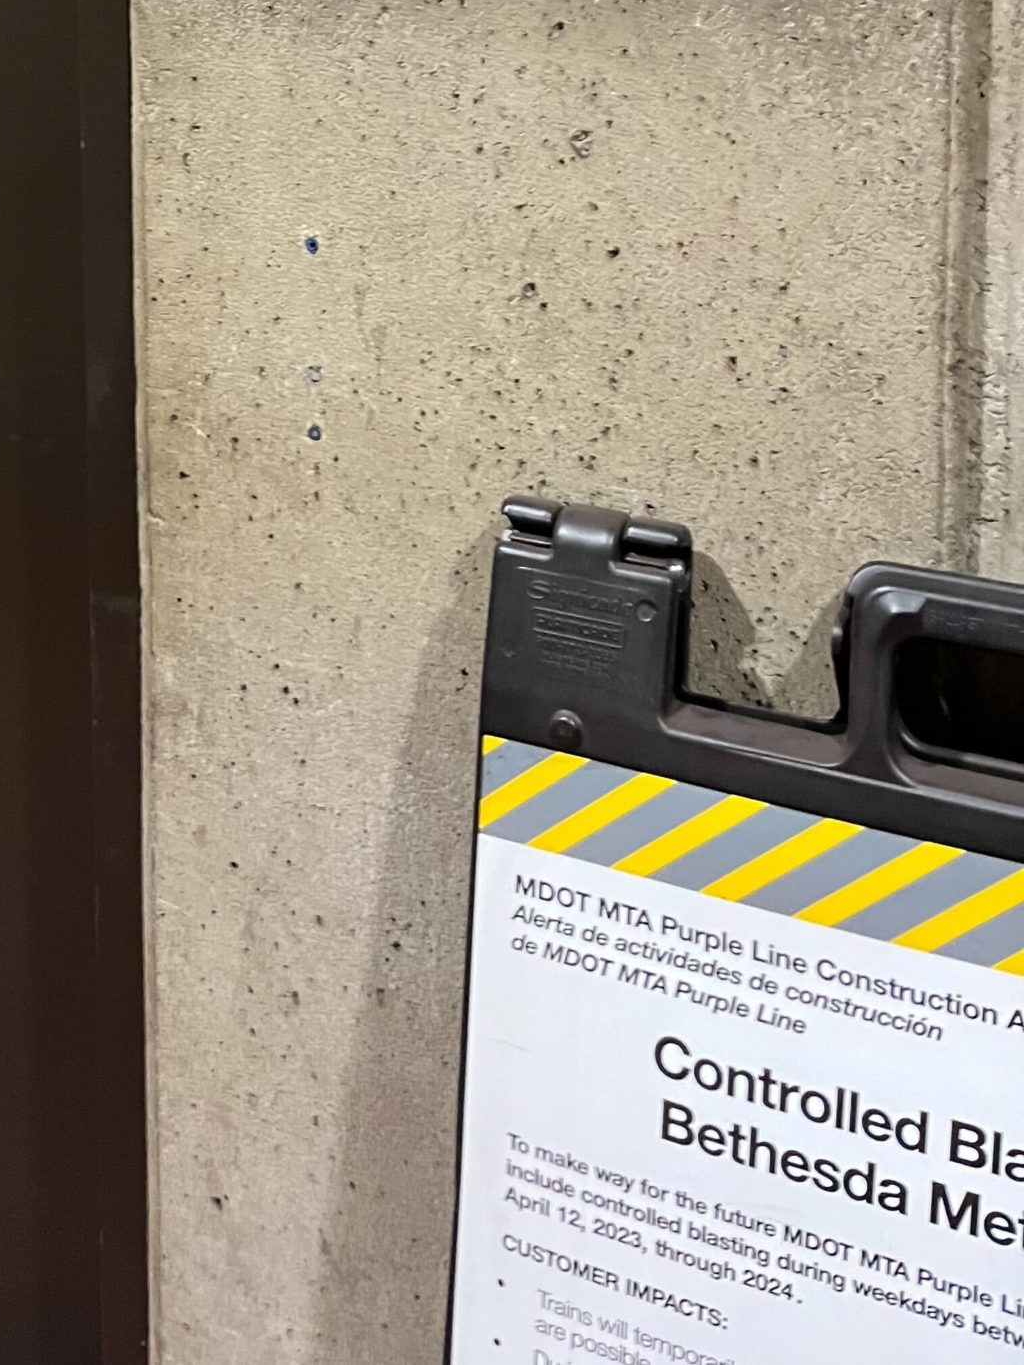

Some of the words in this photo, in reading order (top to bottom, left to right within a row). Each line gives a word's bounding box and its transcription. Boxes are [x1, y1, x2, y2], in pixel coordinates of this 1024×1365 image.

[511, 905, 576, 937] Alerta
[581, 926, 609, 947] de
[614, 937, 743, 985] actividades
[749, 973, 778, 995] de
[785, 984, 943, 1041] construcción
[511, 935, 538, 955] de
[542, 942, 615, 977] MDOT
[618, 964, 668, 995] MTA
[675, 980, 750, 1018] Purple
[757, 1003, 807, 1034] Line
[515, 875, 591, 912] MDOT
[599, 897, 654, 932] MTA
[661, 915, 744, 955] Purple
[753, 939, 807, 973] Line
[817, 959, 998, 1025] Construction
[655, 1036, 929, 1154] Controlled
[507, 1132, 529, 1154] To
[534, 1146, 590, 1175] make
[594, 1166, 635, 1193] way
[641, 1178, 669, 1201] for
[676, 1190, 707, 1214] the
[714, 1203, 776, 1237] future
[783, 1224, 854, 1261] MDOT
[860, 1249, 910, 1282] MTA
[917, 1267, 993, 1307] Purple
[661, 1098, 908, 1215] Bethesda
[929, 1180, 1024, 1251] Me
[502, 1233, 620, 1292] CUSTOMER
[626, 1278, 729, 1329] IMPACTS:
[504, 1187, 551, 1217] April
[558, 1206, 586, 1233] 12,
[593, 1218, 648, 1254] 2023,
[655, 1239, 737, 1281] through
[742, 1269, 803, 1304] 2024.
[505, 1158, 576, 1198] include
[581, 1189, 682, 1235] controlled
[688, 1221, 771, 1267] blasting
[777, 1254, 846, 1293] during
[853, 1279, 966, 1329] weekdays
[534, 1319, 566, 1341] are
[536, 1288, 593, 1327] Trains
[597, 1315, 628, 1340] will
